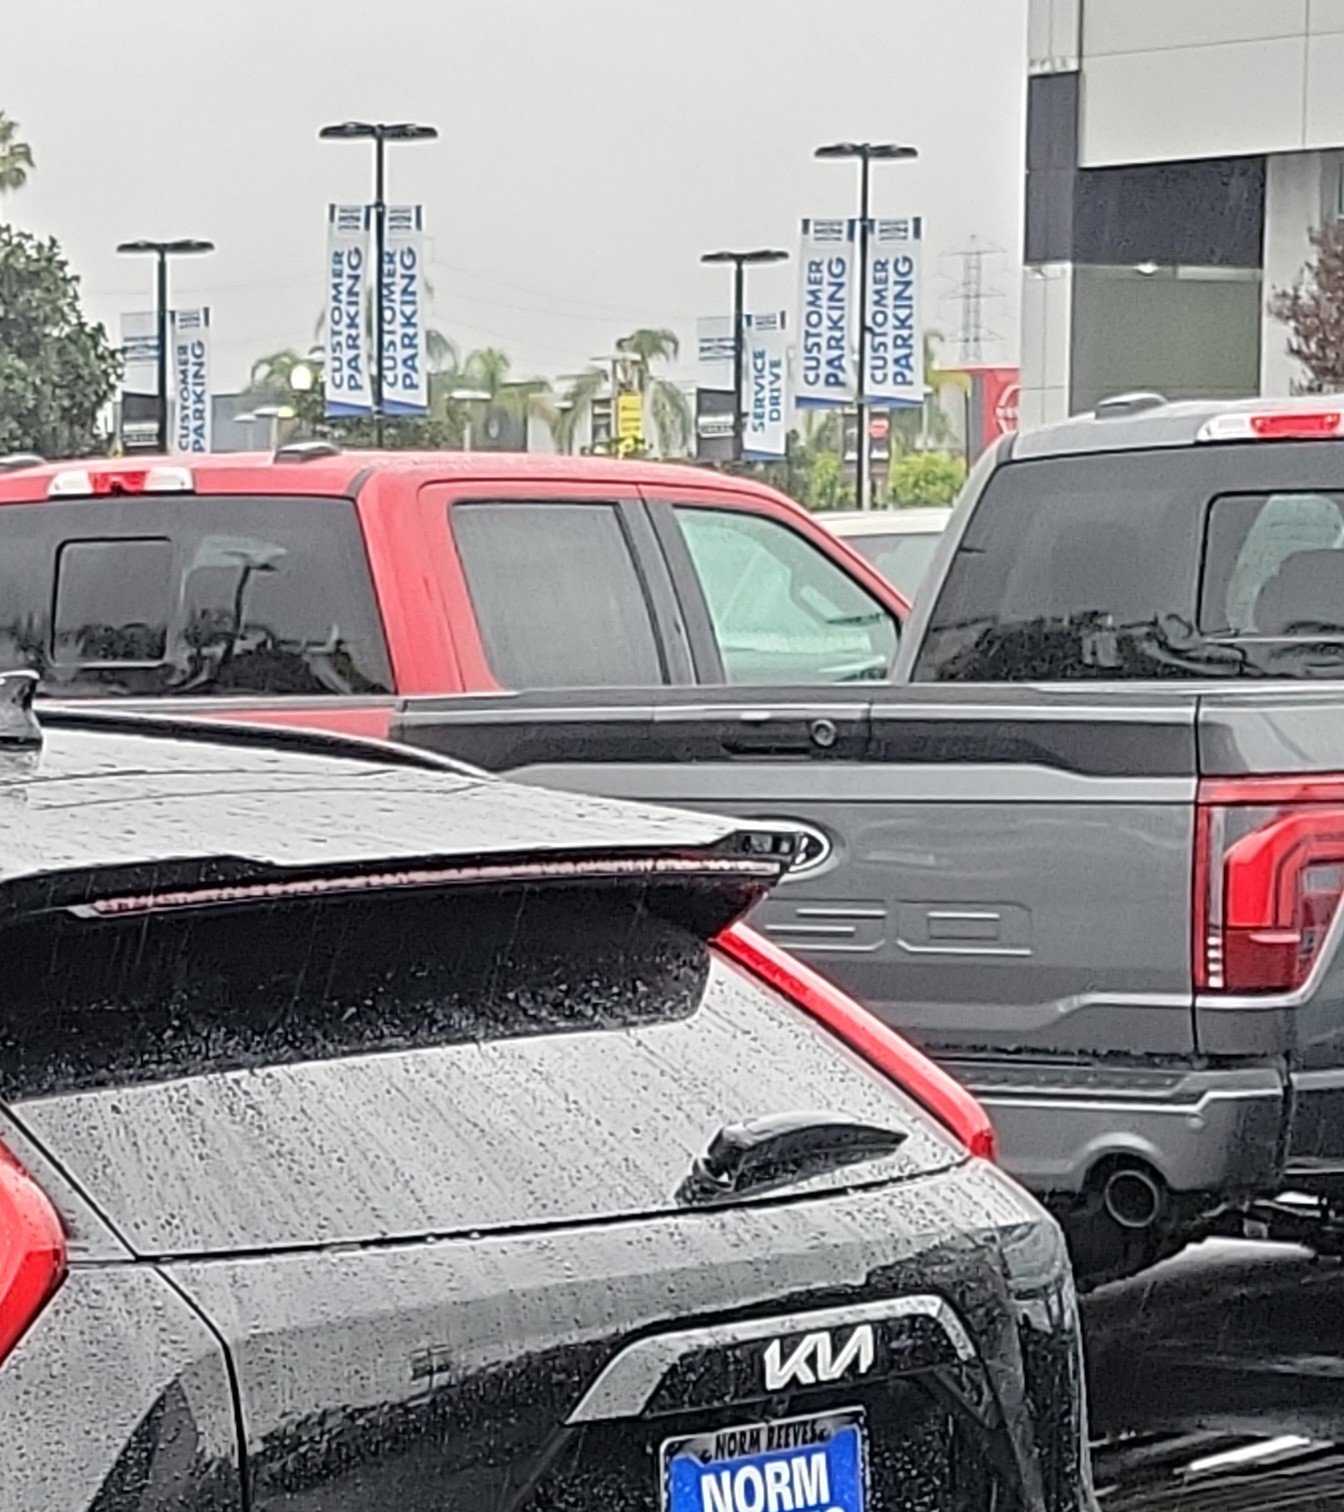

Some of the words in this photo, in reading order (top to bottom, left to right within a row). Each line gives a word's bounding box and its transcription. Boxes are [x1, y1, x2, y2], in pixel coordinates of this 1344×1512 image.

[330, 250, 345, 390] CUSTOMER
[346, 246, 363, 391] PARKING
[382, 249, 398, 388] CUSTOMER
[400, 246, 419, 390] PARKING
[803, 258, 824, 387] CUSTOMER
[824, 256, 847, 388] PARKING
[870, 258, 889, 385] CUSTOMER
[892, 255, 914, 387] PARKING
[177, 344, 190, 451] CUSTOMER
[191, 340, 206, 453] PARKING
[752, 349, 766, 432] SERVICE
[768, 359, 782, 422] DRIVE
[763, 1324, 875, 1391] KIA
[715, 1429, 762, 1461] NORM
